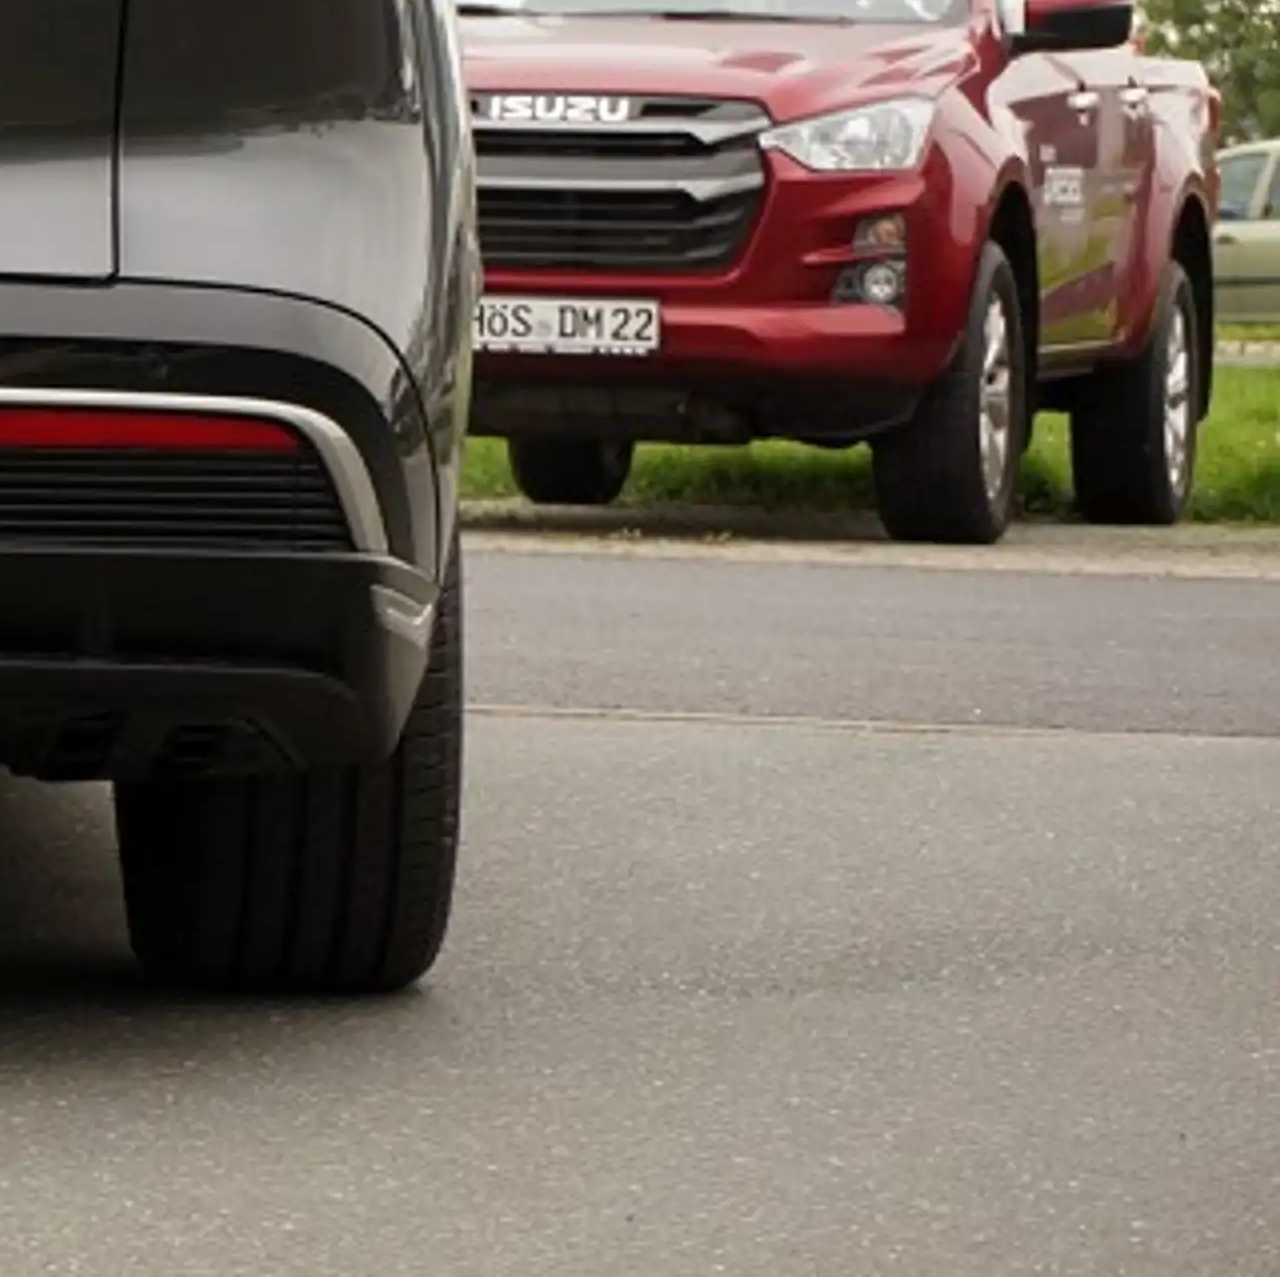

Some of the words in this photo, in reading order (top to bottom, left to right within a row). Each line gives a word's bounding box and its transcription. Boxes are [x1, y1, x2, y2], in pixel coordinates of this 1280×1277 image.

[490, 95, 630, 122] ISUZU
[558, 305, 604, 339] DM
[610, 308, 654, 342] 22
